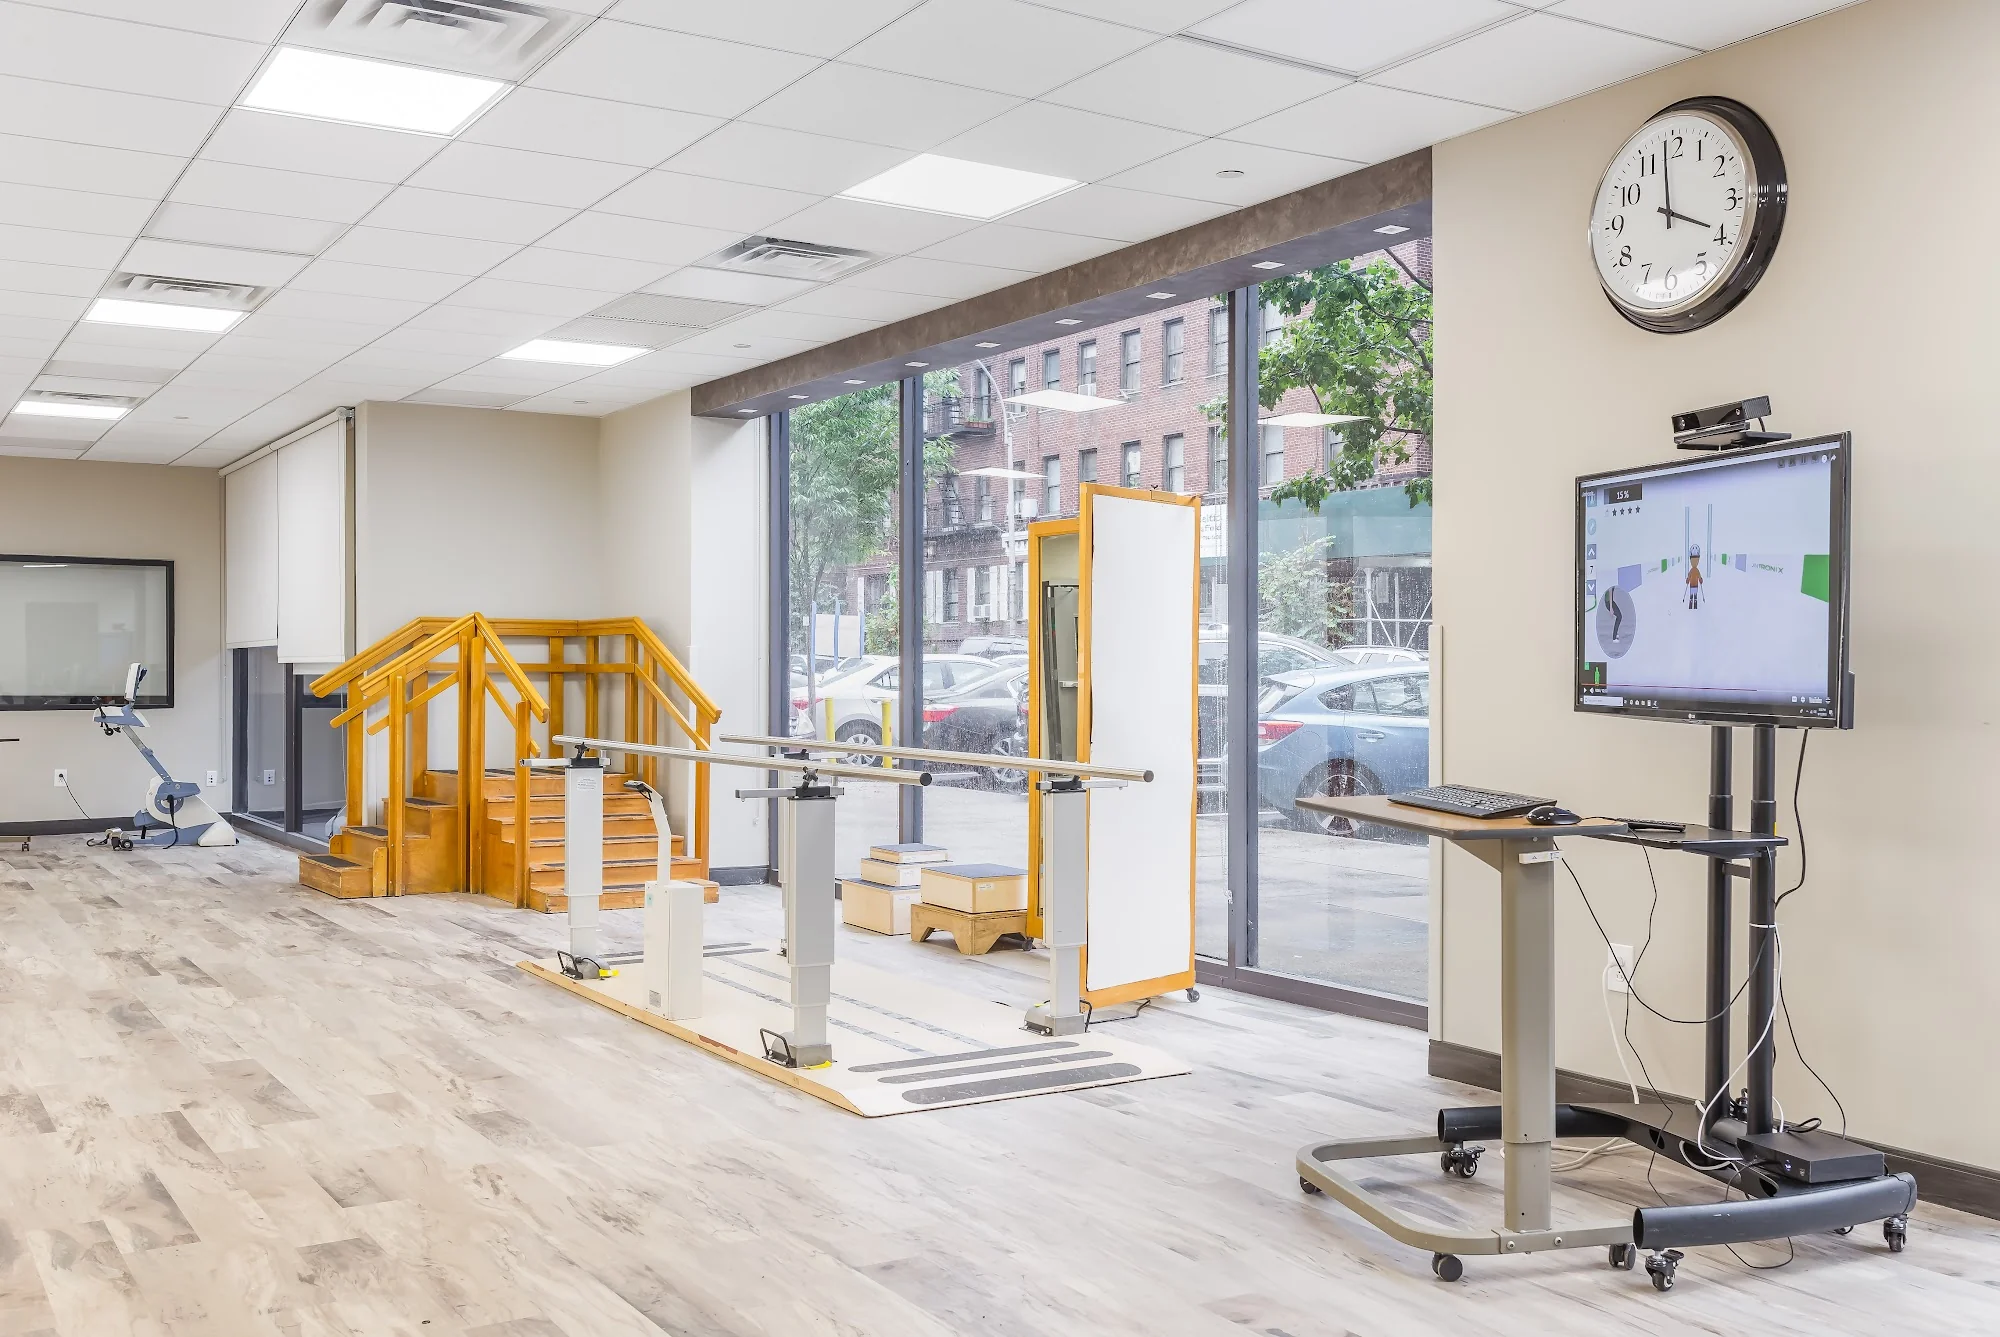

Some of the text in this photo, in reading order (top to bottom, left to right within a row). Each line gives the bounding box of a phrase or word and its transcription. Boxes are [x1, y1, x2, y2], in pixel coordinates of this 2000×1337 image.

[1661, 136, 1684, 161] 2
[1695, 139, 1703, 162] 1
[1638, 153, 1657, 178] 11
[1712, 154, 1726, 178] 2
[1620, 182, 1641, 208] 10
[1723, 187, 1737, 211] 3
[1611, 214, 1625, 239] 9
[1712, 223, 1727, 246] 4
[1619, 245, 1632, 267] 8
[1695, 251, 1708, 276] 5
[1641, 262, 1653, 285] 7
[1664, 265, 1678, 291] 6
[1616, 490, 1630, 500] 15%
[1589, 565, 1594, 574] 7
